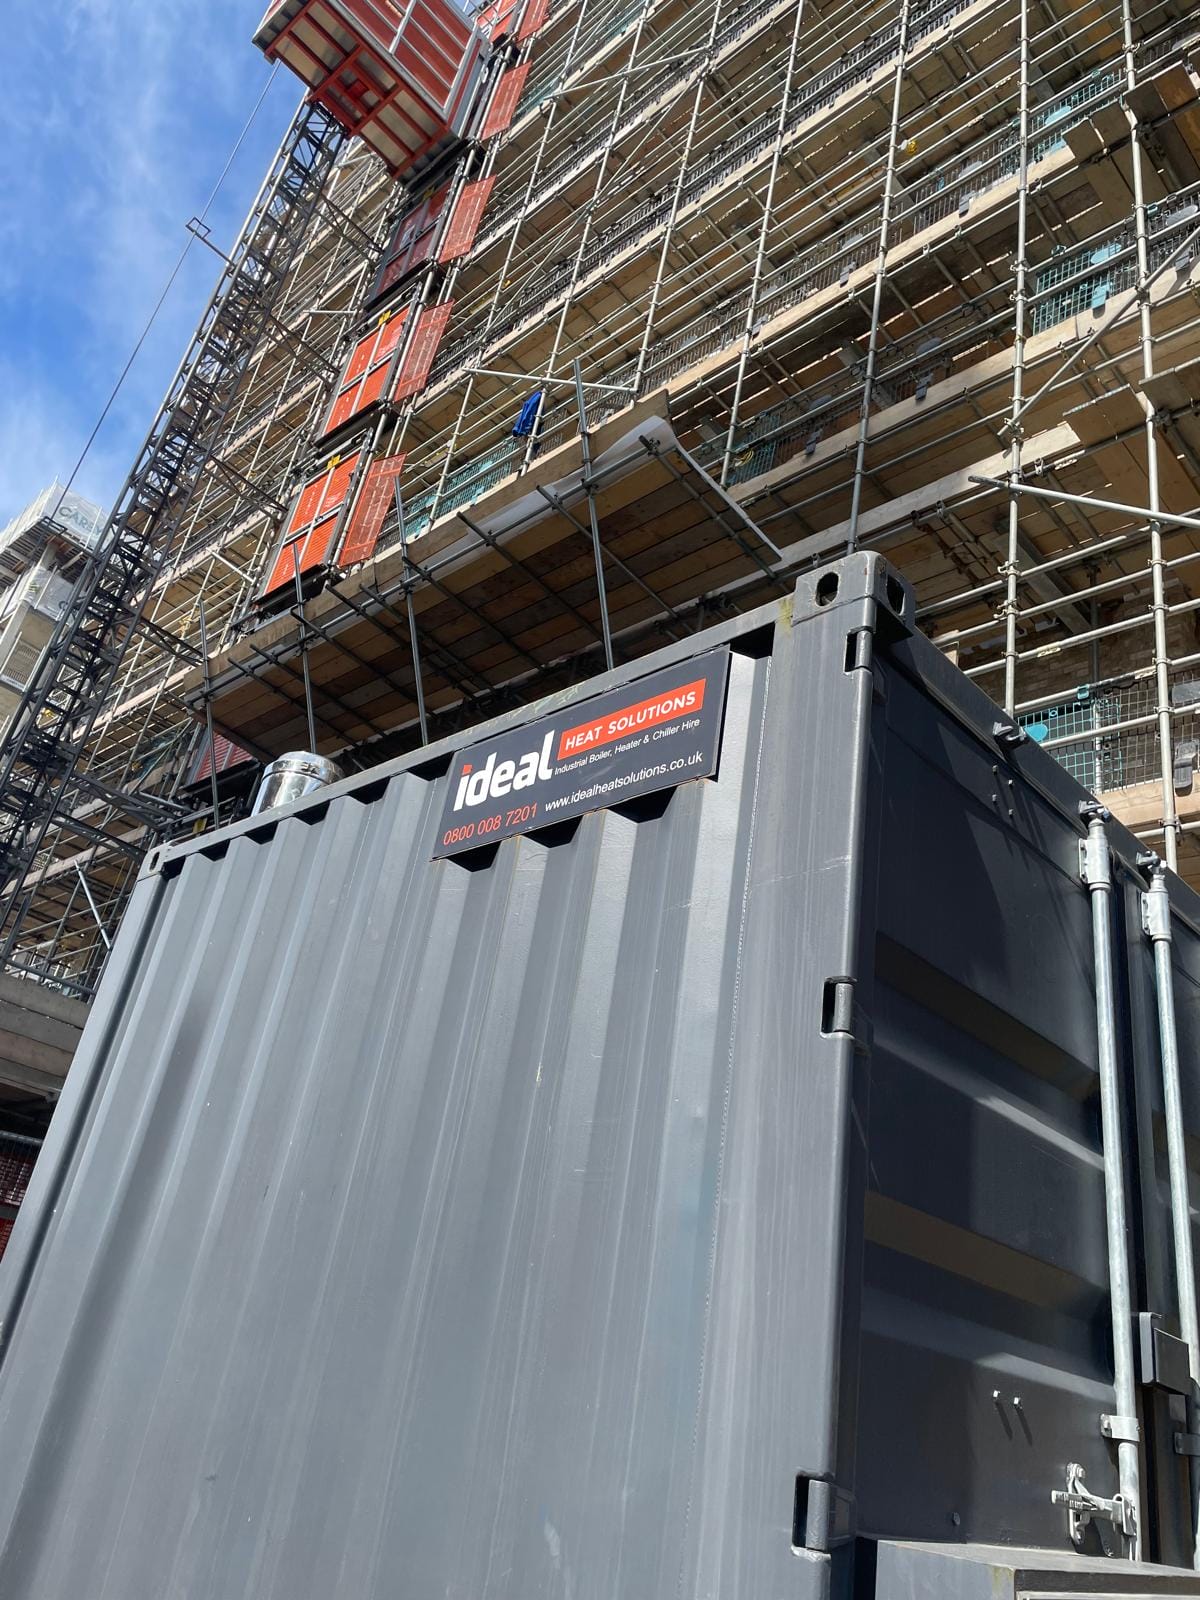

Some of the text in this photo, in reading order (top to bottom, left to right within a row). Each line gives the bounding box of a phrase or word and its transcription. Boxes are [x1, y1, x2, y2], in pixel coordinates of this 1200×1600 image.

[554, 718, 701, 776] Industrial Boiler, Heater & Chiller Hire
[565, 691, 696, 751] HEAT SOLUTIONS
[453, 729, 555, 812] ideal
[545, 751, 703, 812] www.idealheatsolutions.co.uk
[443, 802, 538, 846] 0800 008 7201
